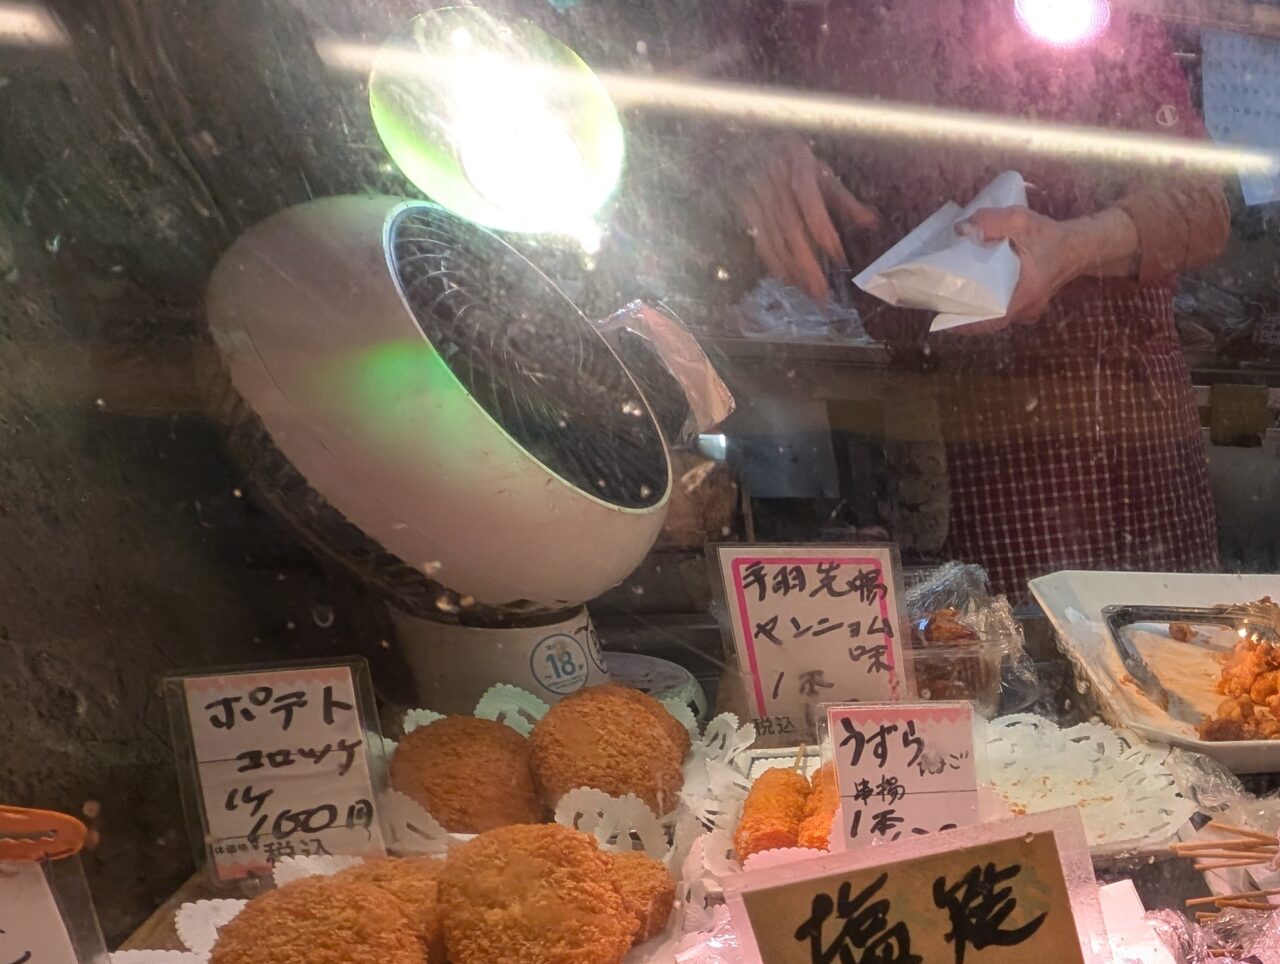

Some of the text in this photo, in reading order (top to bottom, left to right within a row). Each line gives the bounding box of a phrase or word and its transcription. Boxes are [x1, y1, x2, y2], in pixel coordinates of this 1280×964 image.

[743, 561, 888, 606] 手羽先揚
[754, 615, 894, 646] ヤンニョム
[849, 645, 893, 674] 味
[205, 686, 354, 731] ポテト
[236, 738, 362, 776] コロッケ
[840, 717, 924, 768] うずら
[854, 774, 906, 806] 串揚
